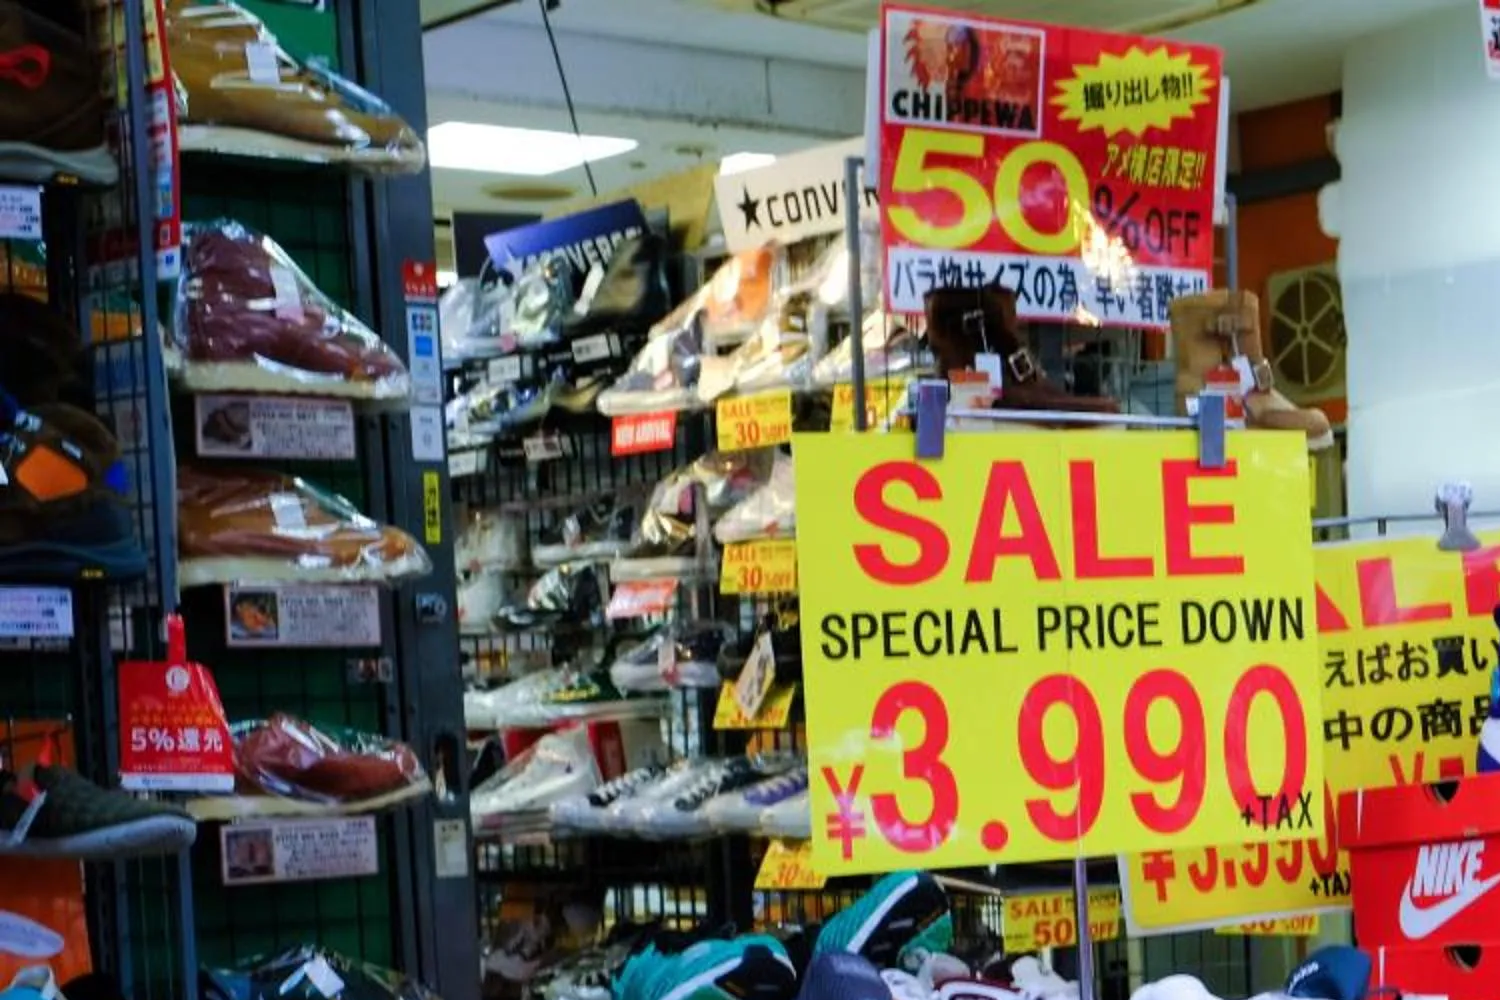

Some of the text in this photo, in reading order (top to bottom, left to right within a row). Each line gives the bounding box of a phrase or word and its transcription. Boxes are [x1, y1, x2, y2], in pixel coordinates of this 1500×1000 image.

[891, 90, 1034, 131] CHIPPEWA
[886, 128, 1090, 256] 50
[736, 421, 760, 446] 30
[852, 458, 1245, 585] SALE
[738, 566, 763, 590] 30
[821, 597, 1304, 660] SPECIAL PRICE DOWN
[821, 663, 1308, 862] ¥3.990
[1240, 790, 1314, 831] +TAX
[1411, 839, 1486, 898] NIKE
[1010, 899, 1062, 921] SALE
[1032, 918, 1073, 947] 50
